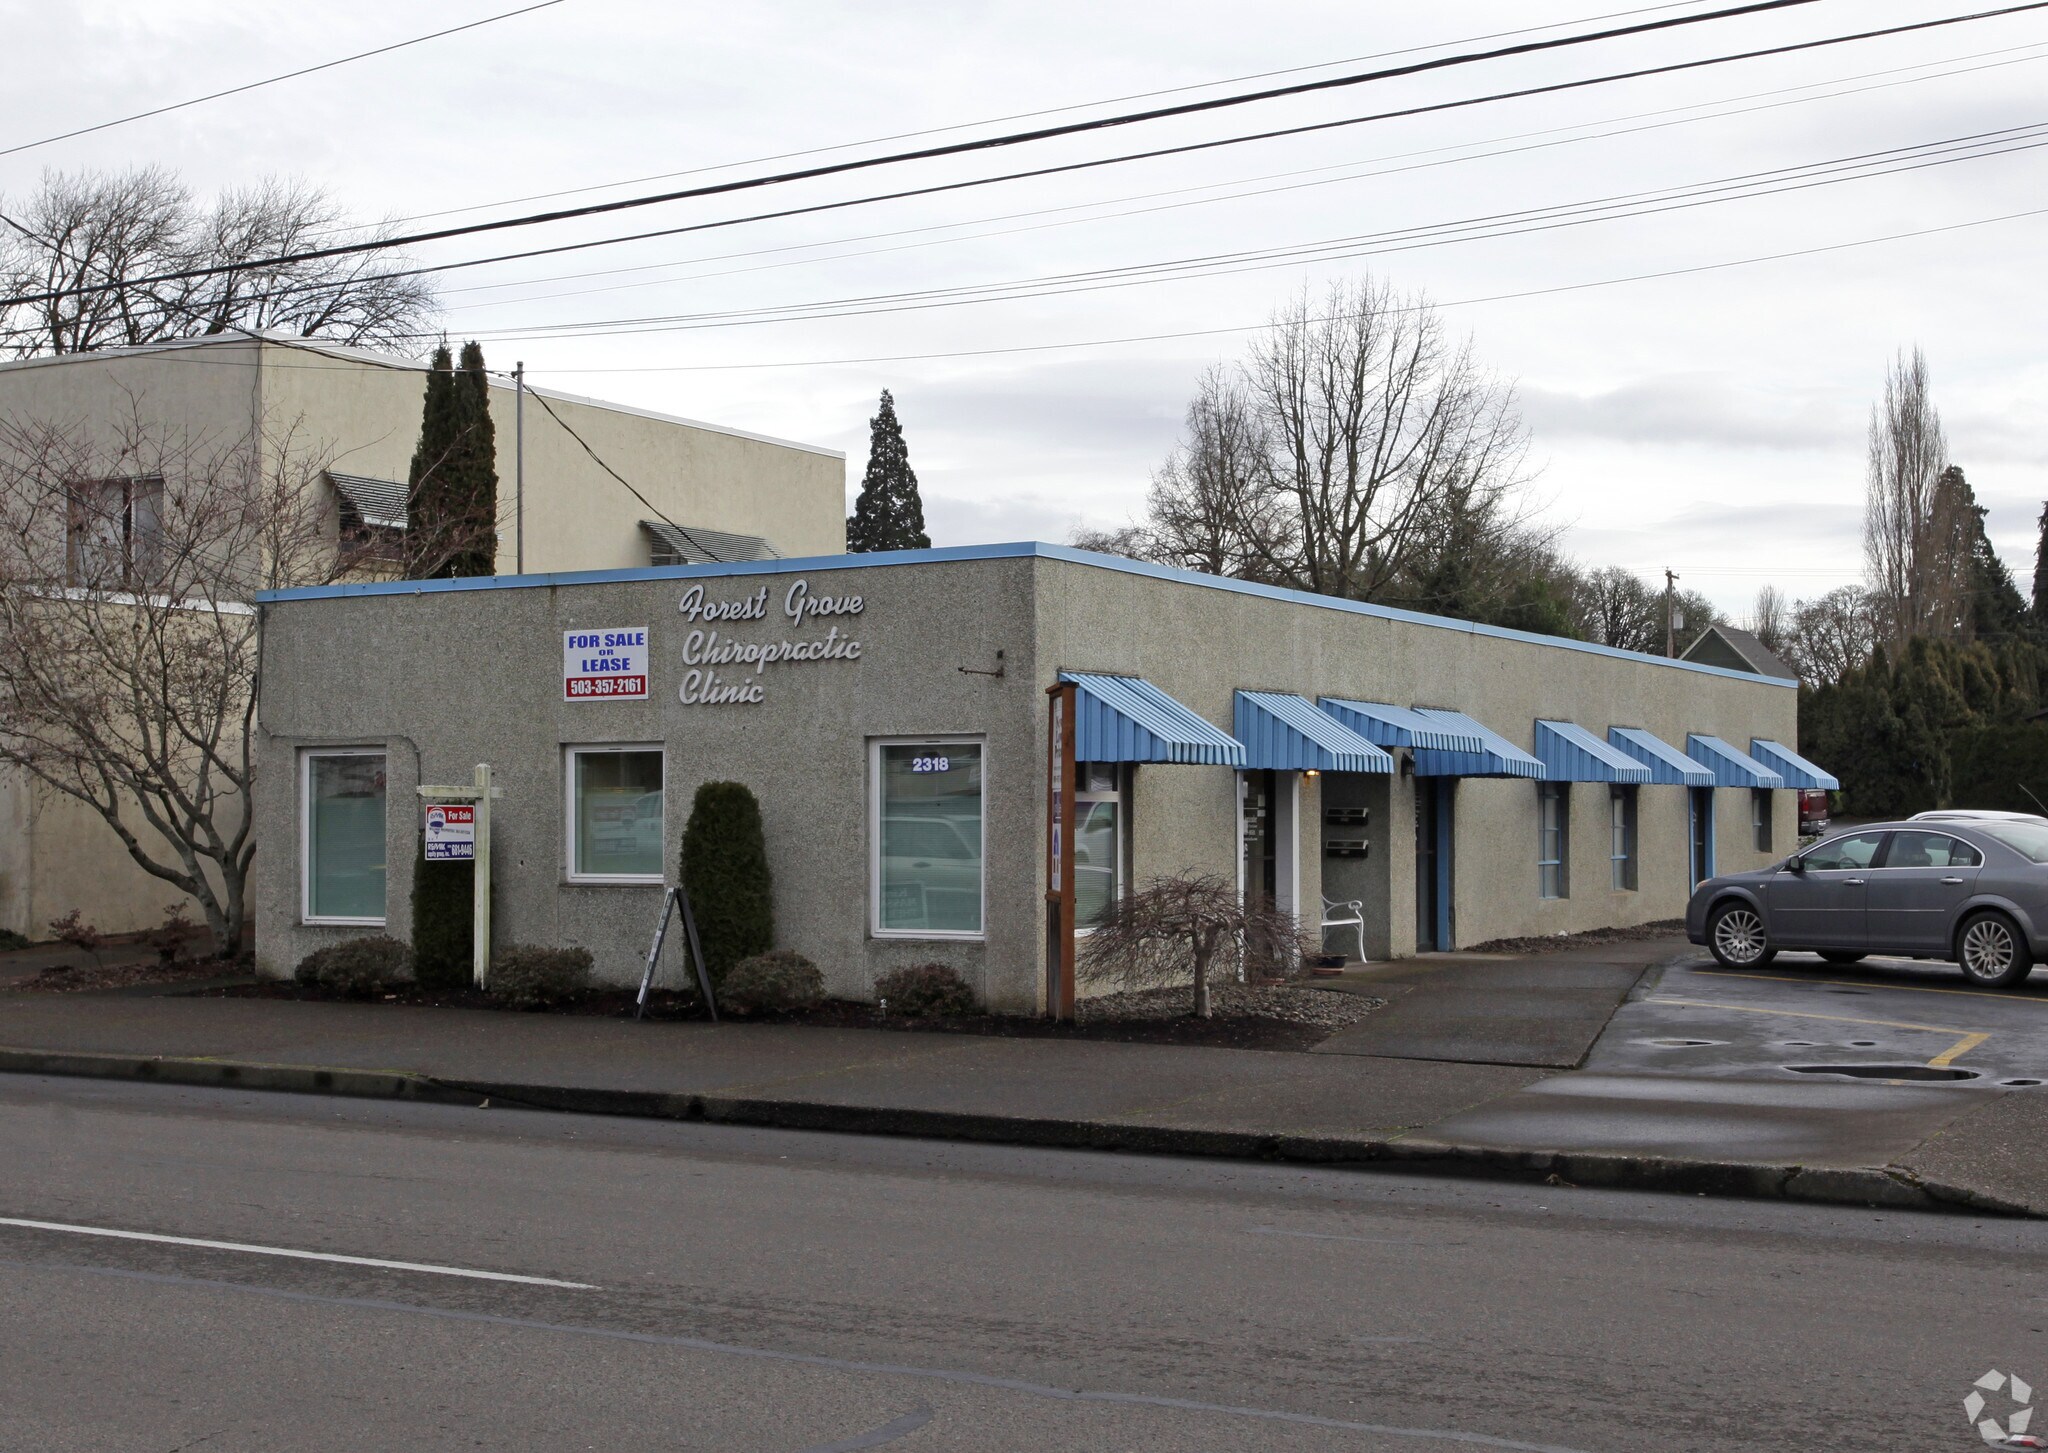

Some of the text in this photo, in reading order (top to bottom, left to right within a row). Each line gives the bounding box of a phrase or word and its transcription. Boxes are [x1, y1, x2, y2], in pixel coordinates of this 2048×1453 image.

[679, 579, 865, 627] Forest Grove
[568, 633, 644, 649] FOR SALE
[682, 626, 862, 674] Chiropractic
[582, 657, 630, 672] LEASE
[570, 677, 641, 695] 503-357-2161
[679, 669, 765, 705] Clinic
[912, 757, 949, 771] 2318
[448, 811, 471, 820] For Sale
